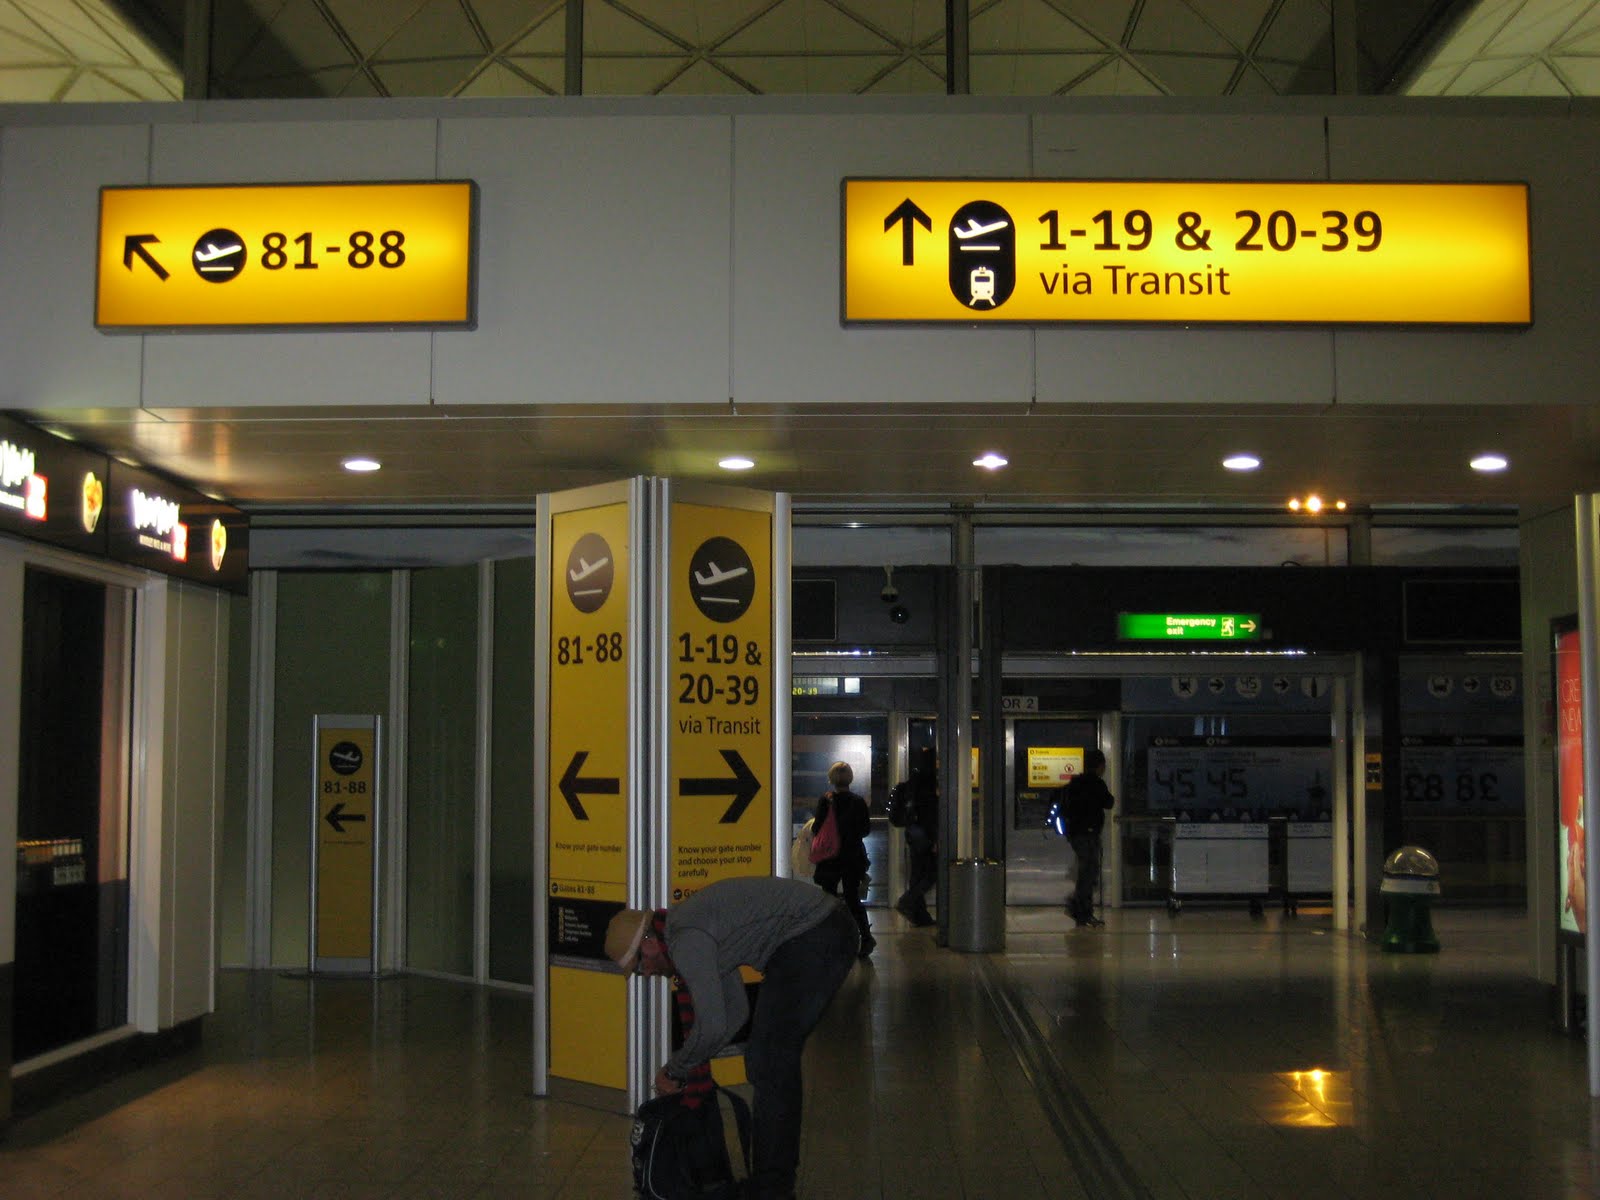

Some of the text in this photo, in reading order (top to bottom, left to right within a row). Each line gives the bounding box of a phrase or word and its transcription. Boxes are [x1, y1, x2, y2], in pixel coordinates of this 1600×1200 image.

[1038, 209, 1383, 253] 1-19 & 20-39
[261, 230, 406, 270] 81-88
[1039, 264, 1230, 295] via Transit
[1166, 616, 1216, 627] Emergency
[1166, 627, 1184, 636] exit
[558, 632, 623, 665] 81-88
[679, 632, 762, 665] 1-19 &
[679, 673, 759, 705] 20-39
[1027, 698, 1034, 709] 2
[679, 715, 761, 735] via Transit
[324, 781, 366, 794] 81-88
[678, 843, 761, 854] Know your gate number
[678, 858, 692, 866] and
[719, 856, 735, 866] your
[737, 855, 752, 864] stop
[678, 868, 708, 877] carefully
